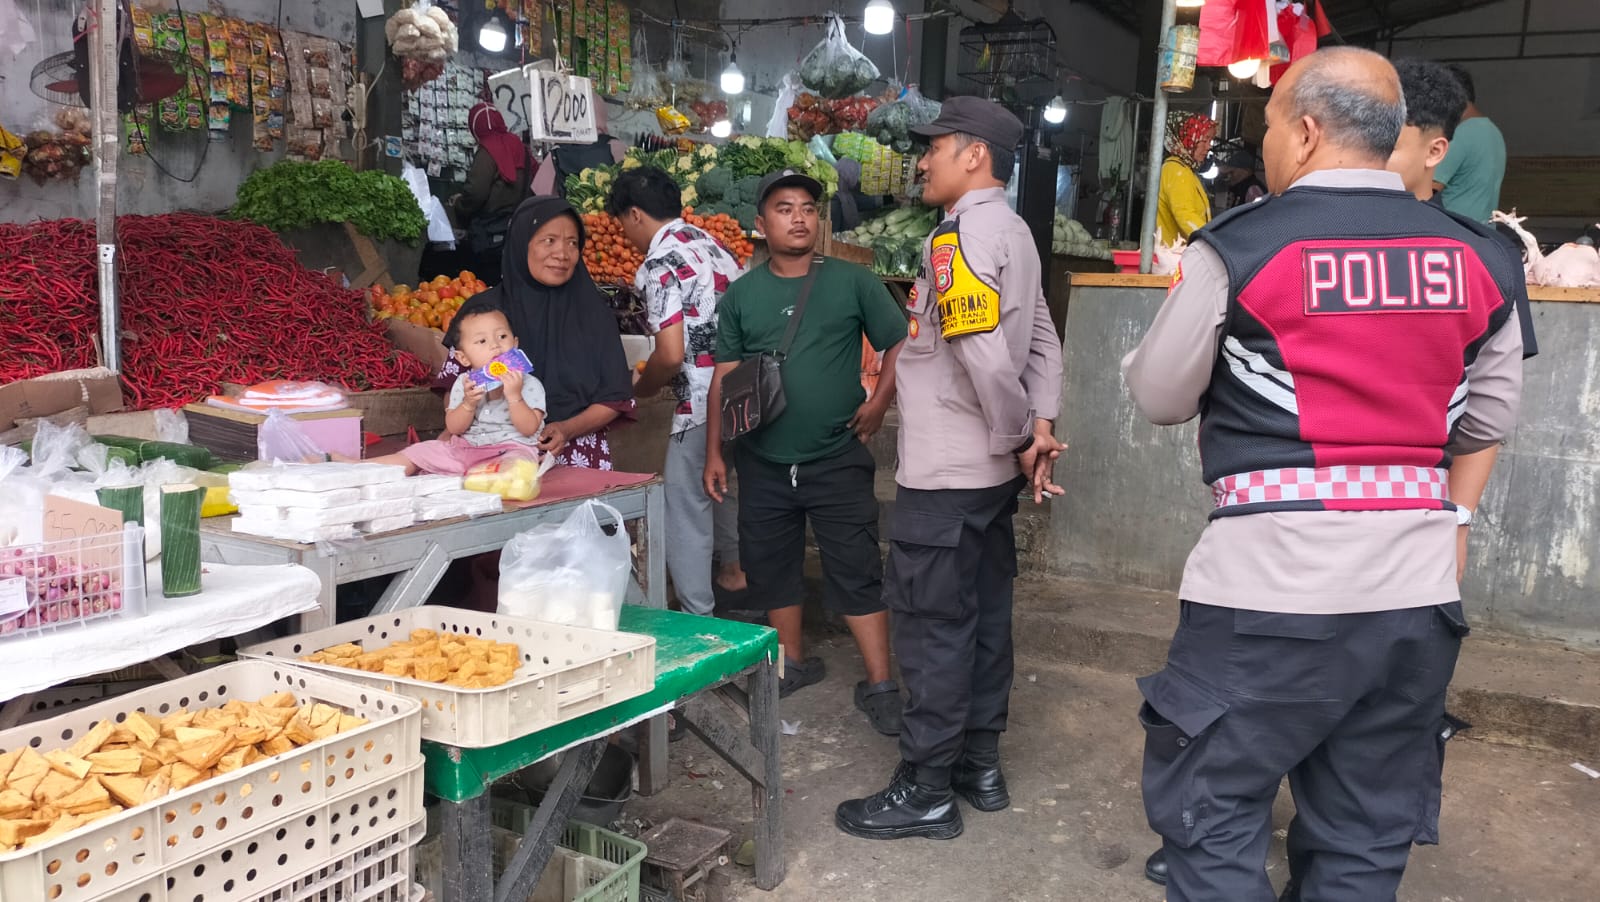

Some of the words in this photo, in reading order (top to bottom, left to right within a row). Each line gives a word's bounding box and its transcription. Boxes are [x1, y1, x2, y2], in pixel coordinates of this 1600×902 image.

[1308, 251, 1465, 307] POLISI
[961, 311, 986, 319] RANJI
[962, 317, 987, 326] TIMUR
